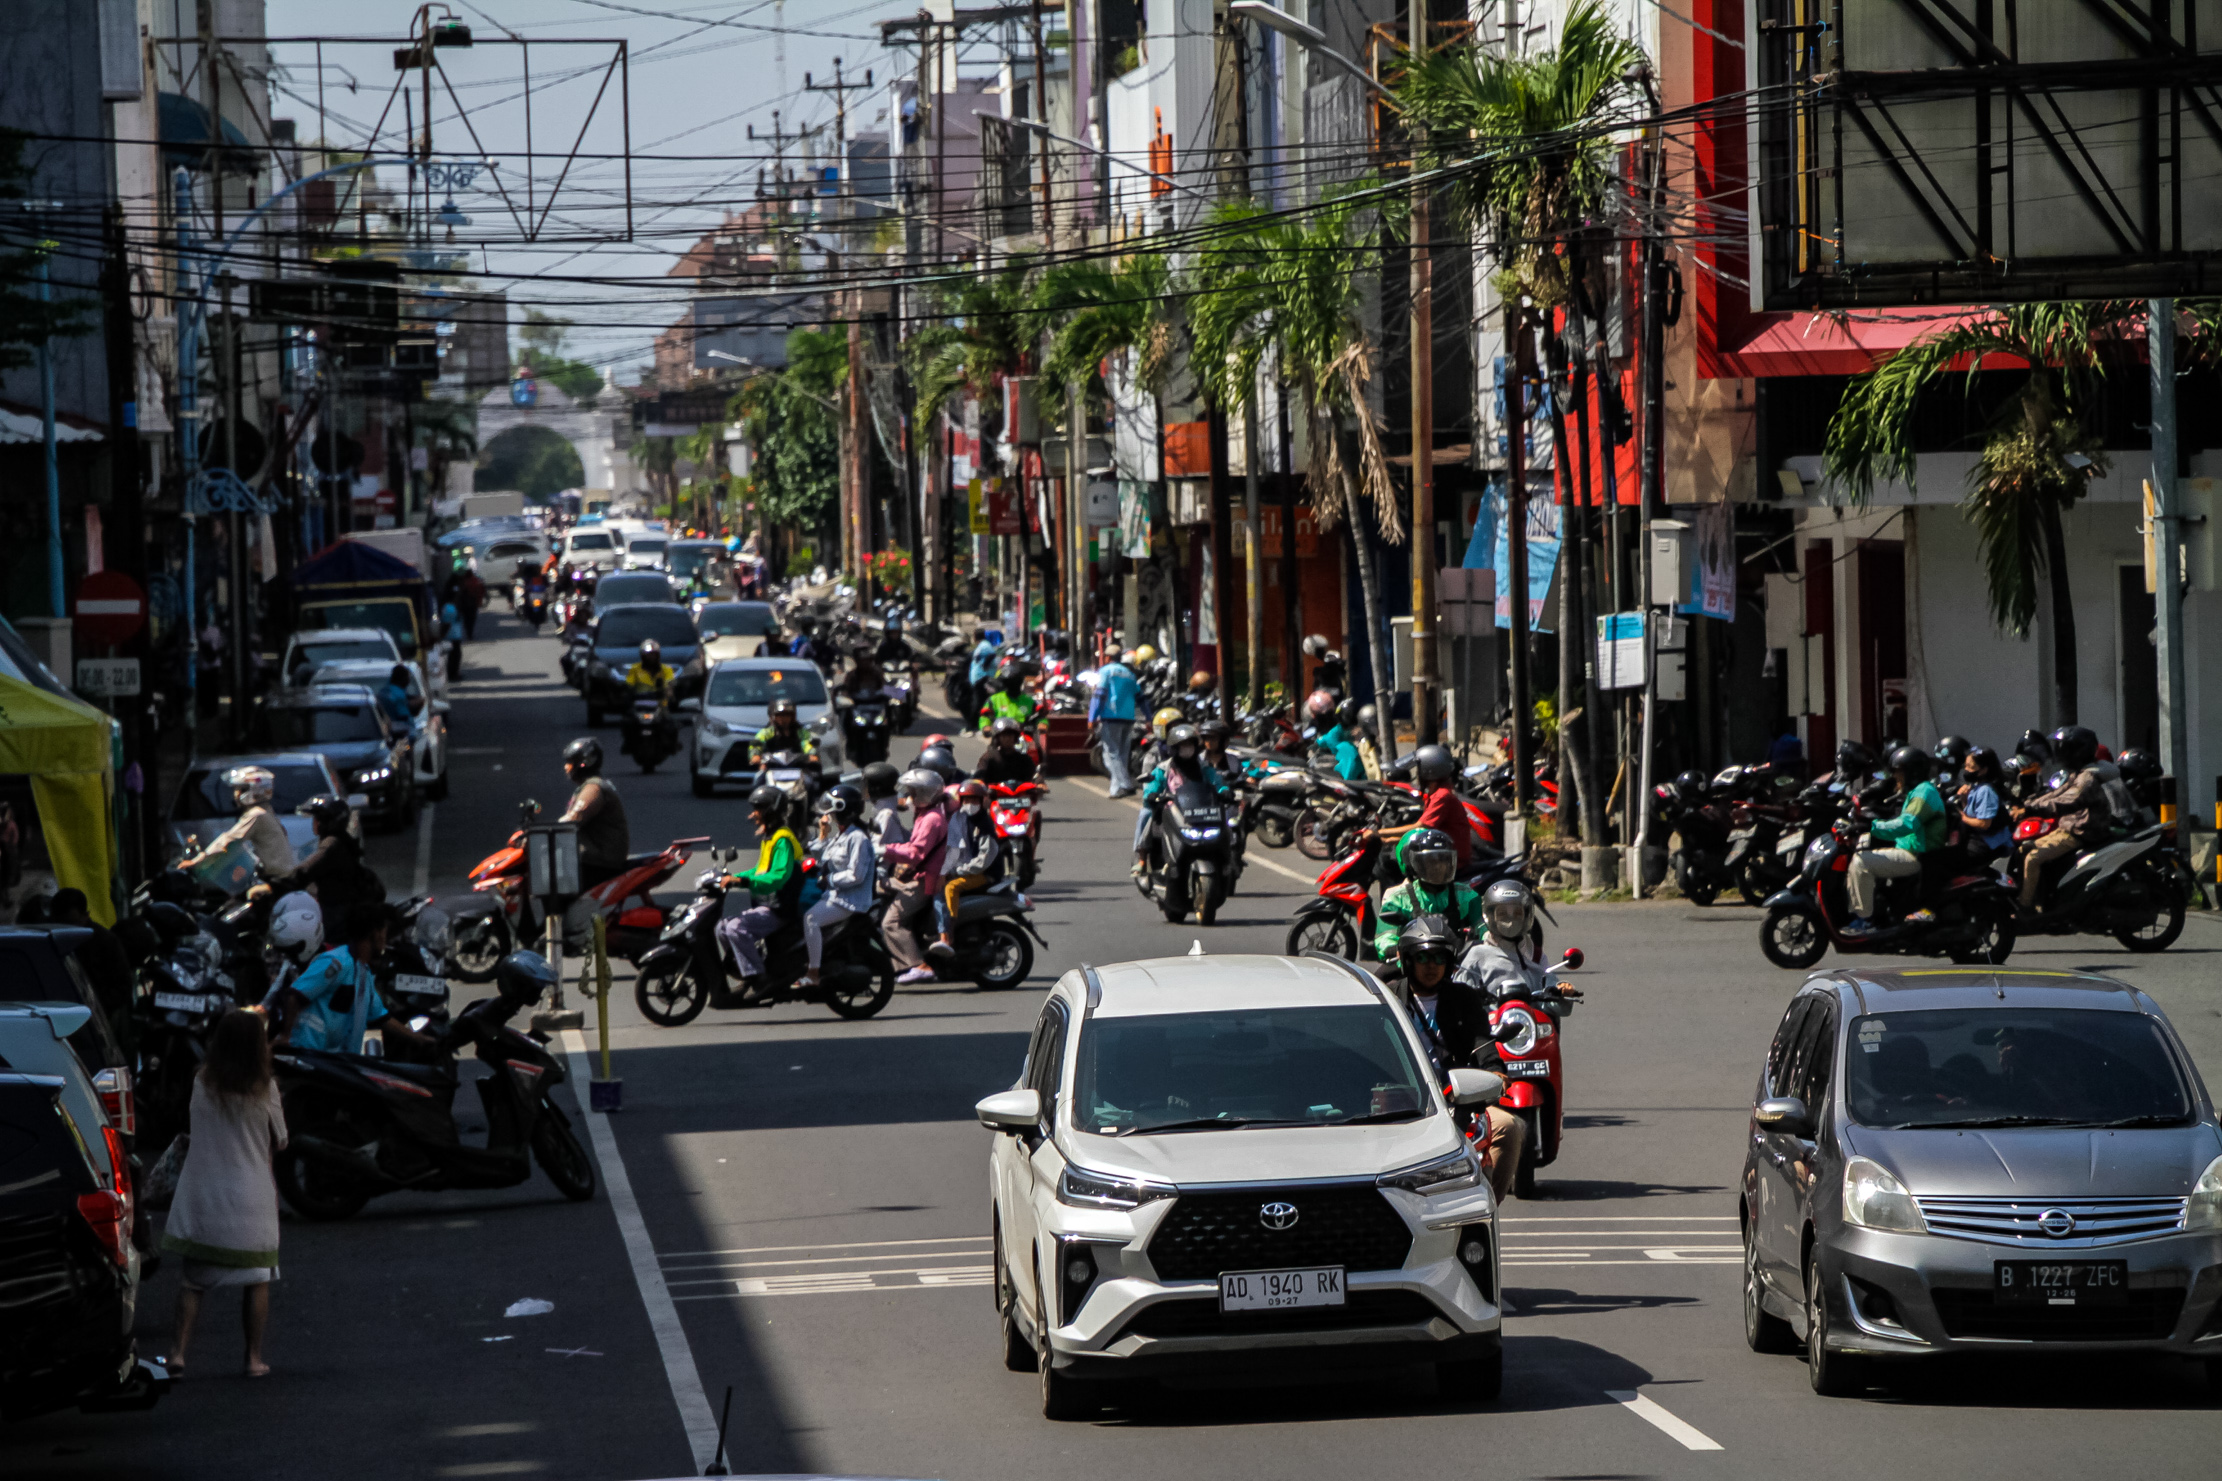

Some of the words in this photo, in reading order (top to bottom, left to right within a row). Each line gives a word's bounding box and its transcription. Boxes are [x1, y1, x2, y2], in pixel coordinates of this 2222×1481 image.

[1227, 1277, 1248, 1298] AD
[1260, 1273, 1303, 1296] 1940
[1317, 1271, 1340, 1294] RK
[2001, 1265, 2013, 1287] B
[2030, 1265, 2073, 1287] 1227
[2087, 1265, 2119, 1287] ZFC
